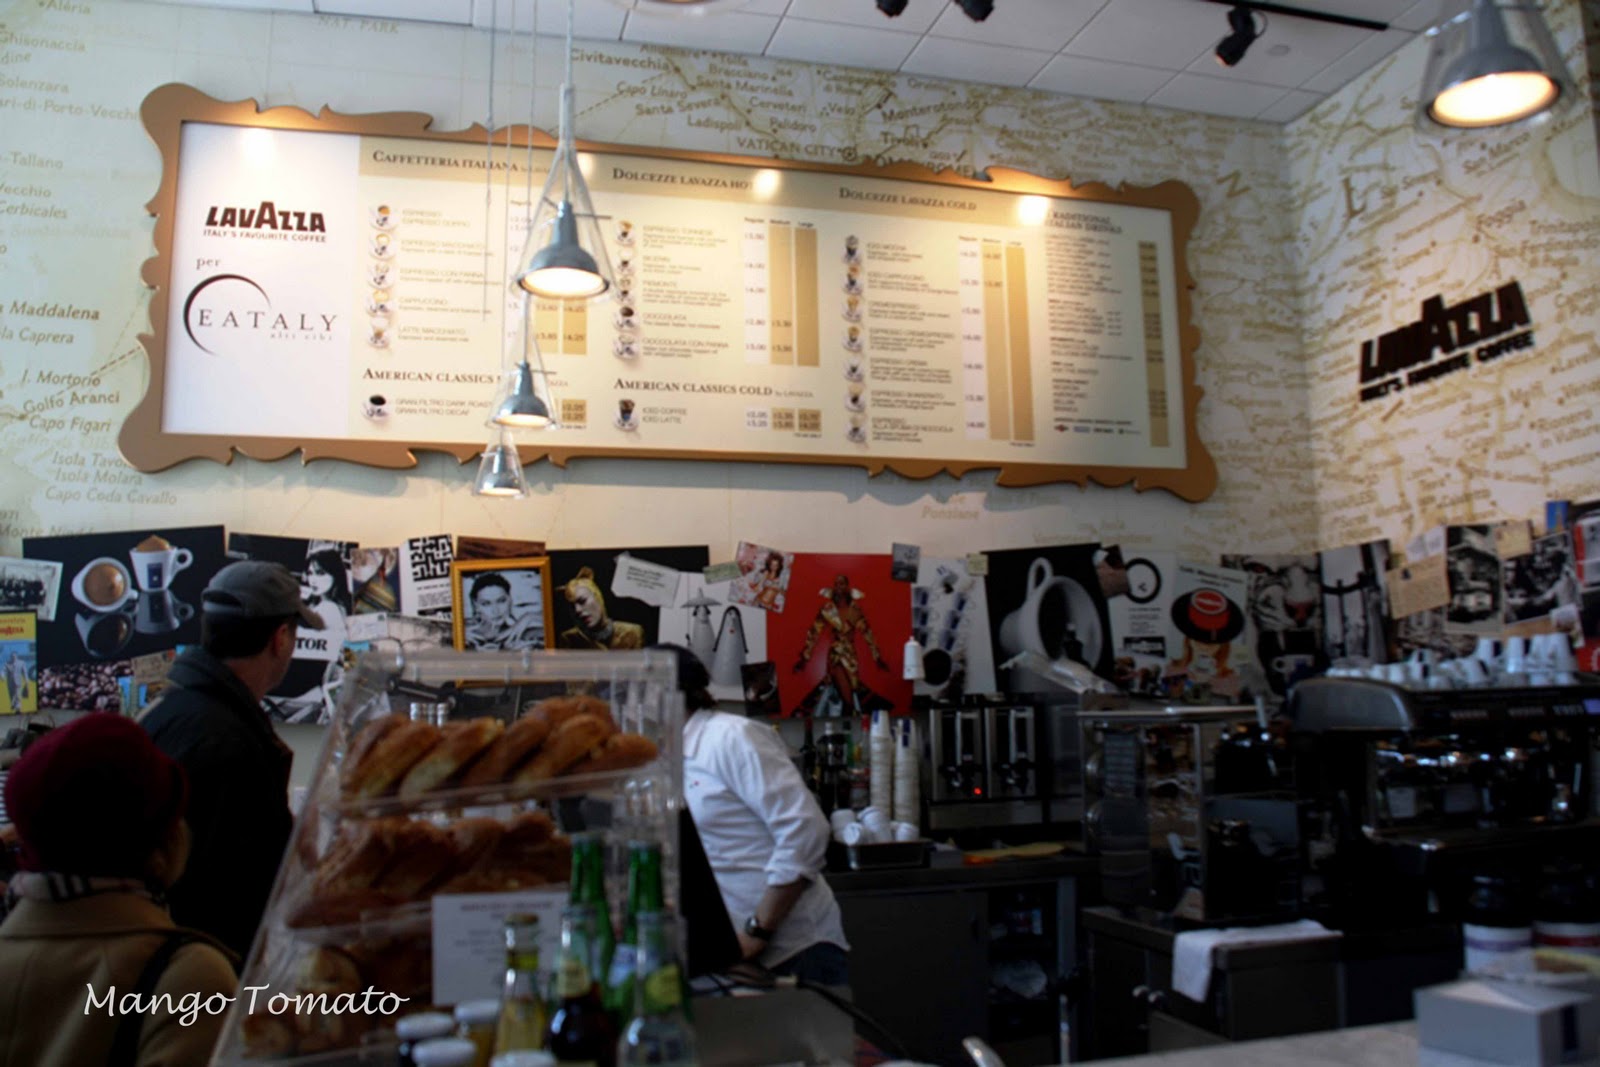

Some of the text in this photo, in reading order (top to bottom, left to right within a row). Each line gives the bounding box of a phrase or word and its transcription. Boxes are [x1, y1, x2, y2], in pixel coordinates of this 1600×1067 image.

[372, 149, 460, 169] CAFFETTERIA
[462, 159, 519, 172] ITALIANA
[611, 166, 677, 185] DOLCEZZE
[680, 175, 728, 189] LAVAZZA
[205, 200, 327, 233] LAVAZZA
[291, 233, 327, 243] COFFEE
[195, 257, 221, 270] per
[9, 300, 100, 320] Maddalena
[197, 308, 338, 332] EATALY
[19, 326, 75, 346] Caprera
[1359, 280, 1532, 385] LAVAZZA
[363, 367, 495, 385] AMERICAN CLASSICS
[613, 377, 680, 392] AMERICAN
[682, 380, 737, 395] CLASSICS
[739, 383, 773, 396] COLD
[70, 391, 120, 407] Aranci
